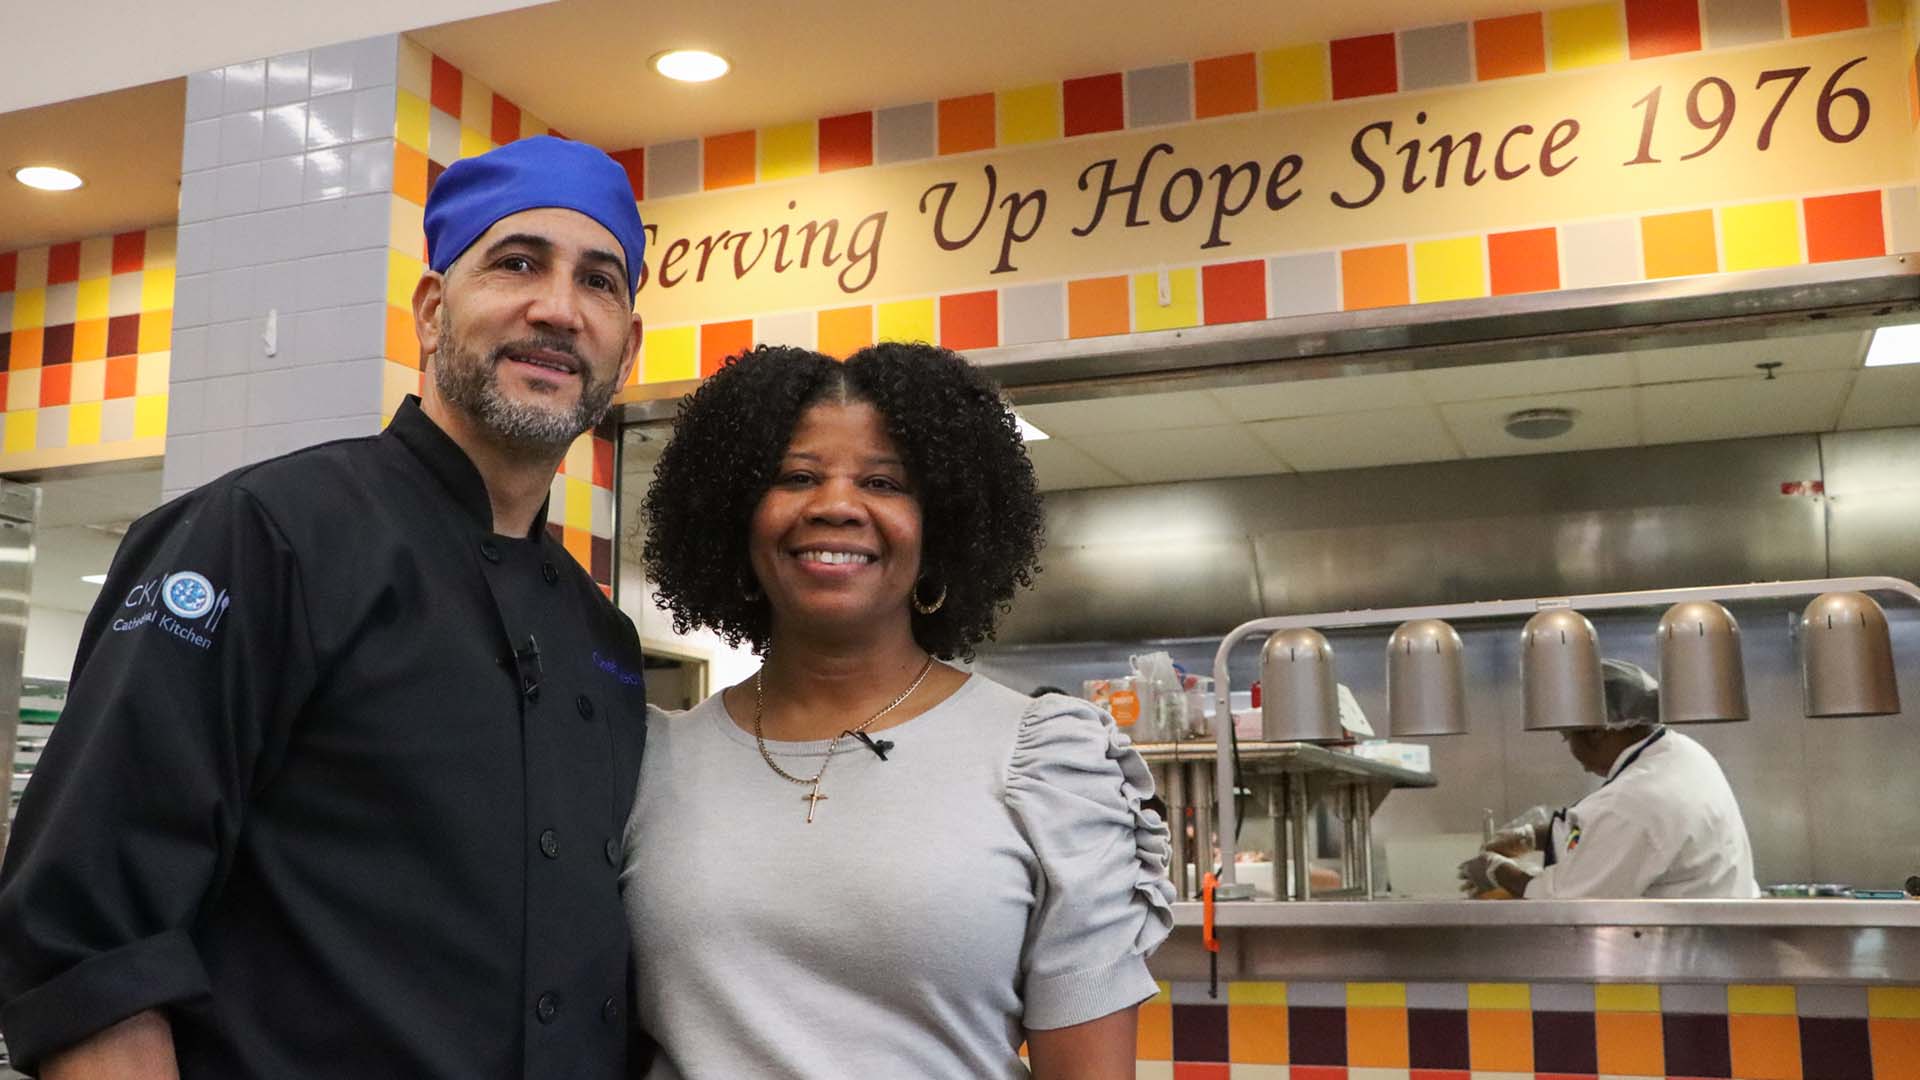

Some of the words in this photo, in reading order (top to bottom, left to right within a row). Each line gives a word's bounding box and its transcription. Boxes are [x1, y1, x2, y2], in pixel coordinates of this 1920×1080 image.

[919, 165, 1046, 274] Up
[1071, 142, 1303, 249] Hope
[1330, 112, 1581, 209] Since
[1623, 57, 1871, 166] 1976
[158, 615, 212, 649] Kitchen
